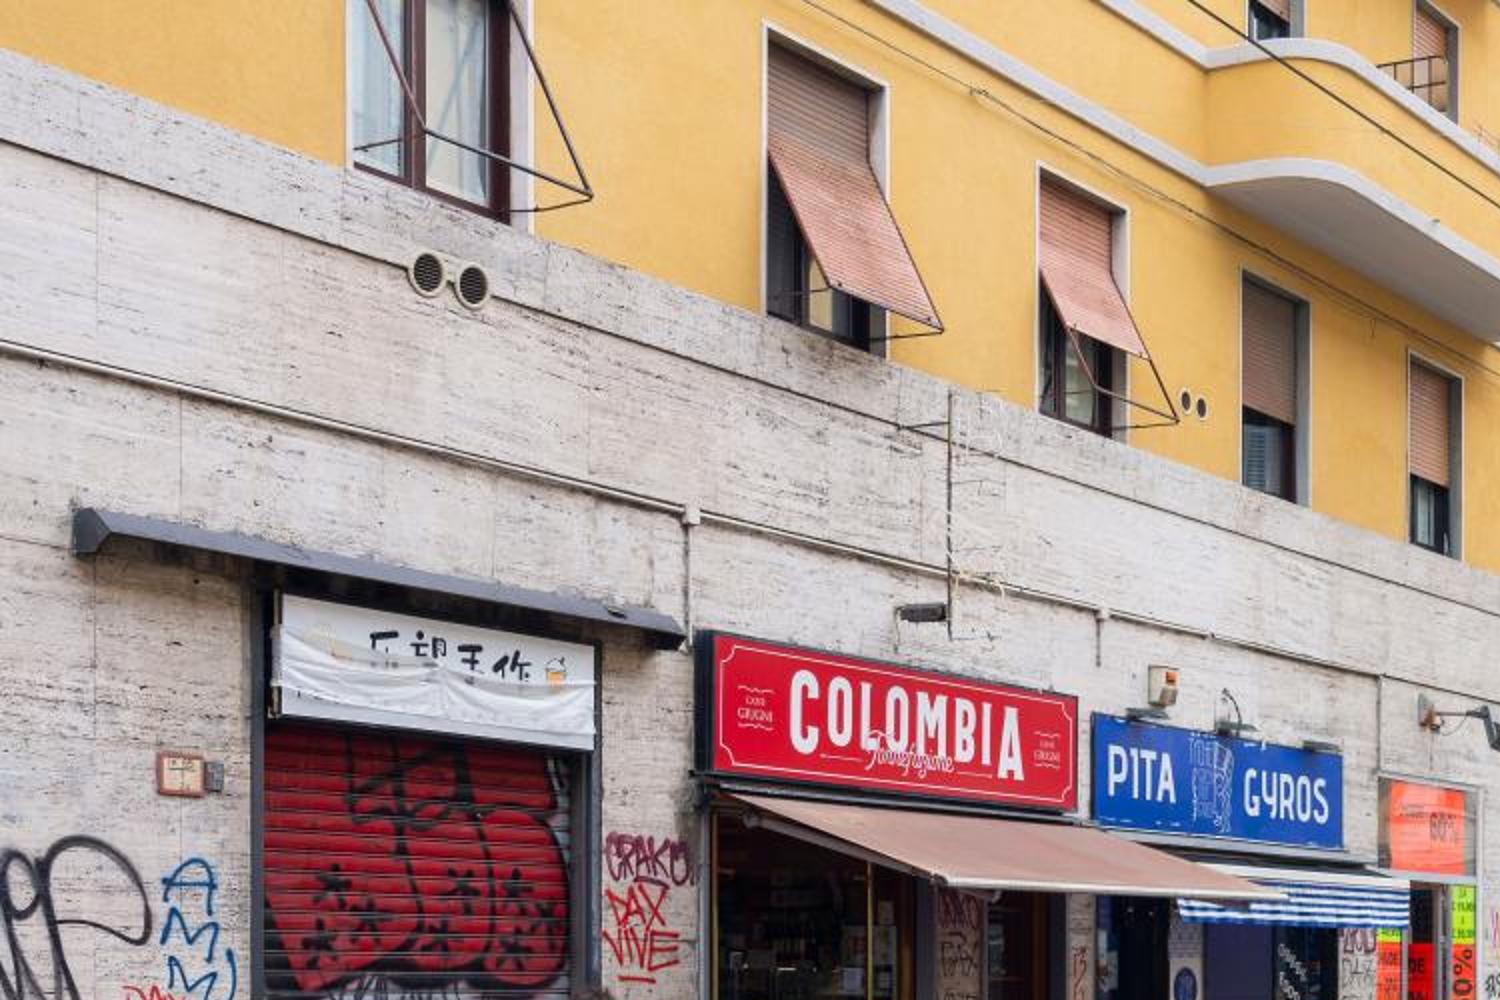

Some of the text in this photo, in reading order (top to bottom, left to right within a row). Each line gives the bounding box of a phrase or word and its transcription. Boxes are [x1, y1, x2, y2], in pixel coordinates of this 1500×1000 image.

[790, 670, 1025, 781] COLOMBIA
[1107, 744, 1177, 804] PITA
[1244, 768, 1329, 825] GYROS
